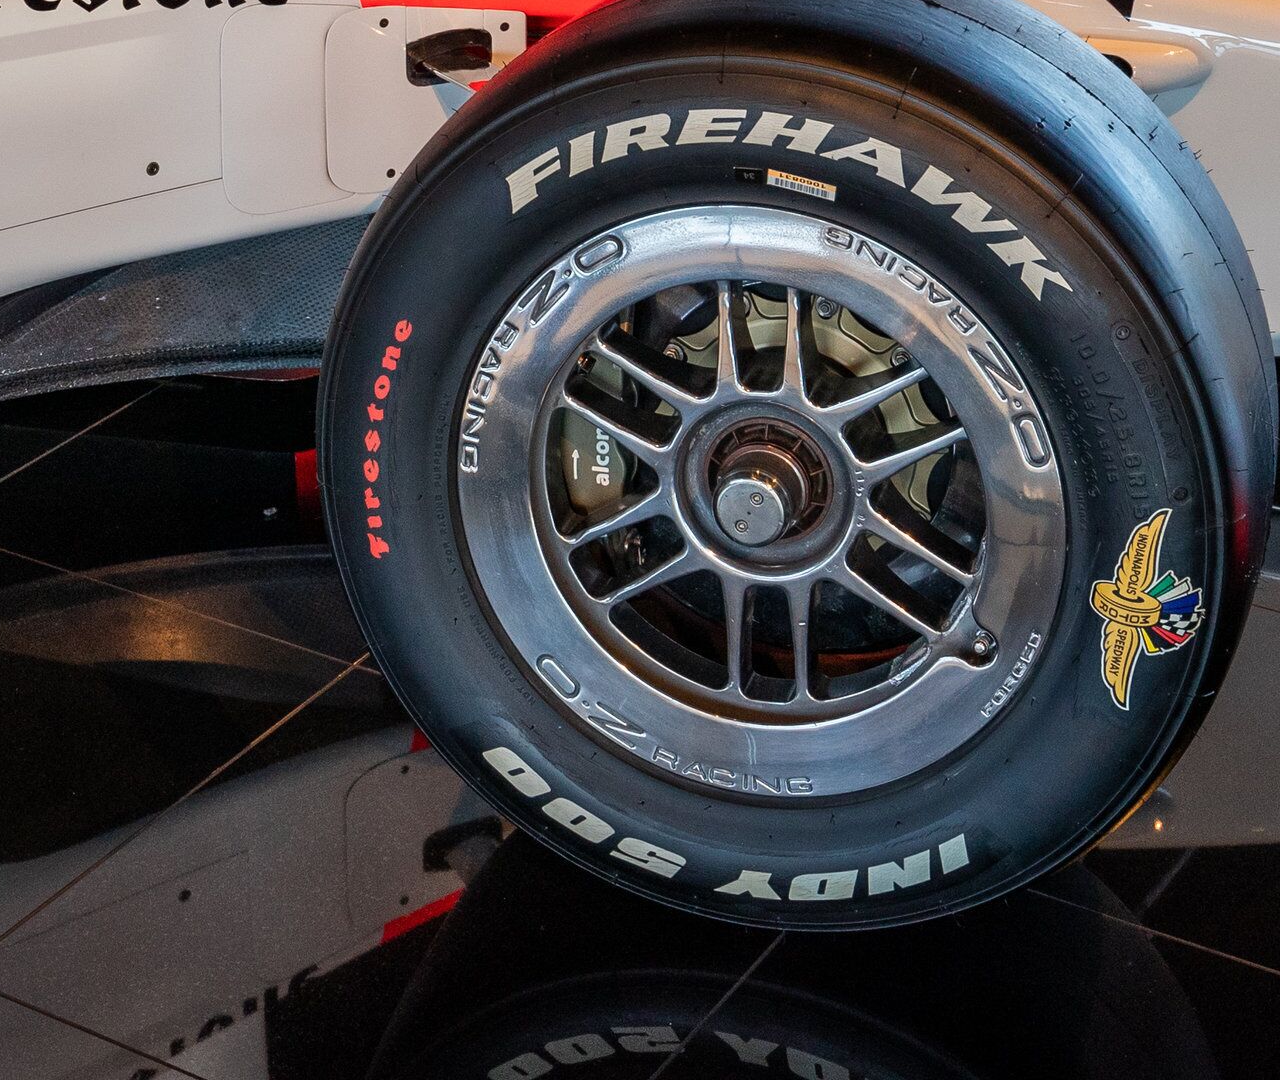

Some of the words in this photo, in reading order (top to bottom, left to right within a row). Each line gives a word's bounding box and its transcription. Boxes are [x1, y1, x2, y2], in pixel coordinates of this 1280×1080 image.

[504, 107, 1074, 302] FIREHAWK
[823, 223, 977, 336] RACING
[362, 319, 413, 559] Firestone
[458, 320, 521, 475] RACING
[1126, 533, 1149, 596] INDIANAPOLIS
[1100, 600, 1152, 625] MOTOR
[1108, 628, 1128, 677] SPEEDWAY
[980, 632, 1042, 718] FORGED
[481, 745, 688, 881] 500
[651, 745, 815, 796] RACING
[713, 831, 970, 902] INDY
